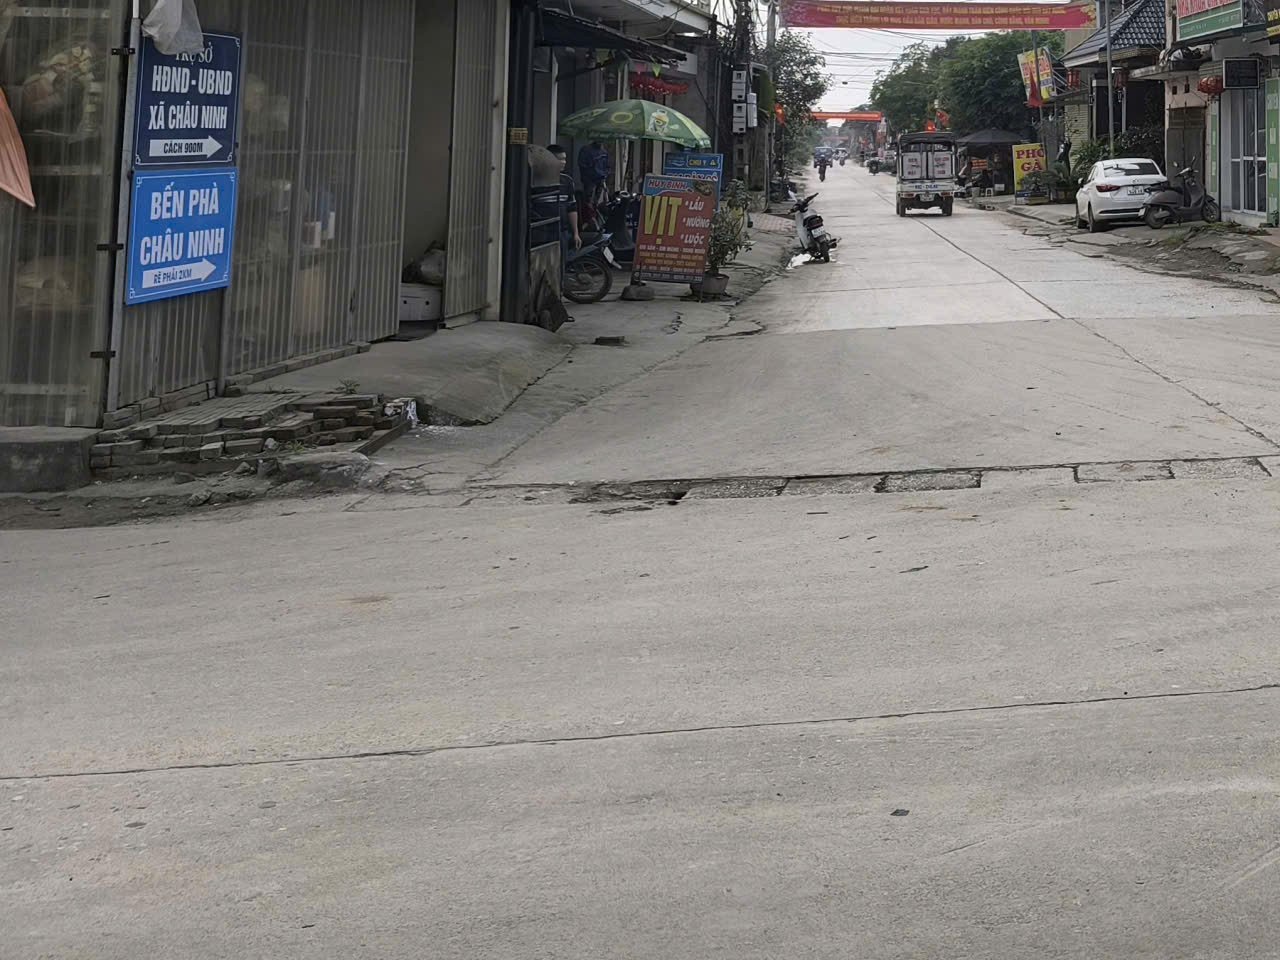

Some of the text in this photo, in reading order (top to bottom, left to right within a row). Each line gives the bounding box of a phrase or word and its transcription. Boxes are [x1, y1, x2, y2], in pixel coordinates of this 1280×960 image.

[198, 41, 214, 64] SỞ
[148, 100, 228, 130] XÃ CHÂU NINH
[163, 140, 204, 154] CÁCH 900M
[1021, 158, 1043, 171] GÀ
[150, 181, 219, 220] BẾN PHÀ
[643, 195, 683, 245] VỊT
[140, 227, 225, 266] CHÂU NINH
[684, 234, 706, 247] LUỘC
[162, 268, 178, 283] PHẢI
[178, 268, 192, 281] 2KM
